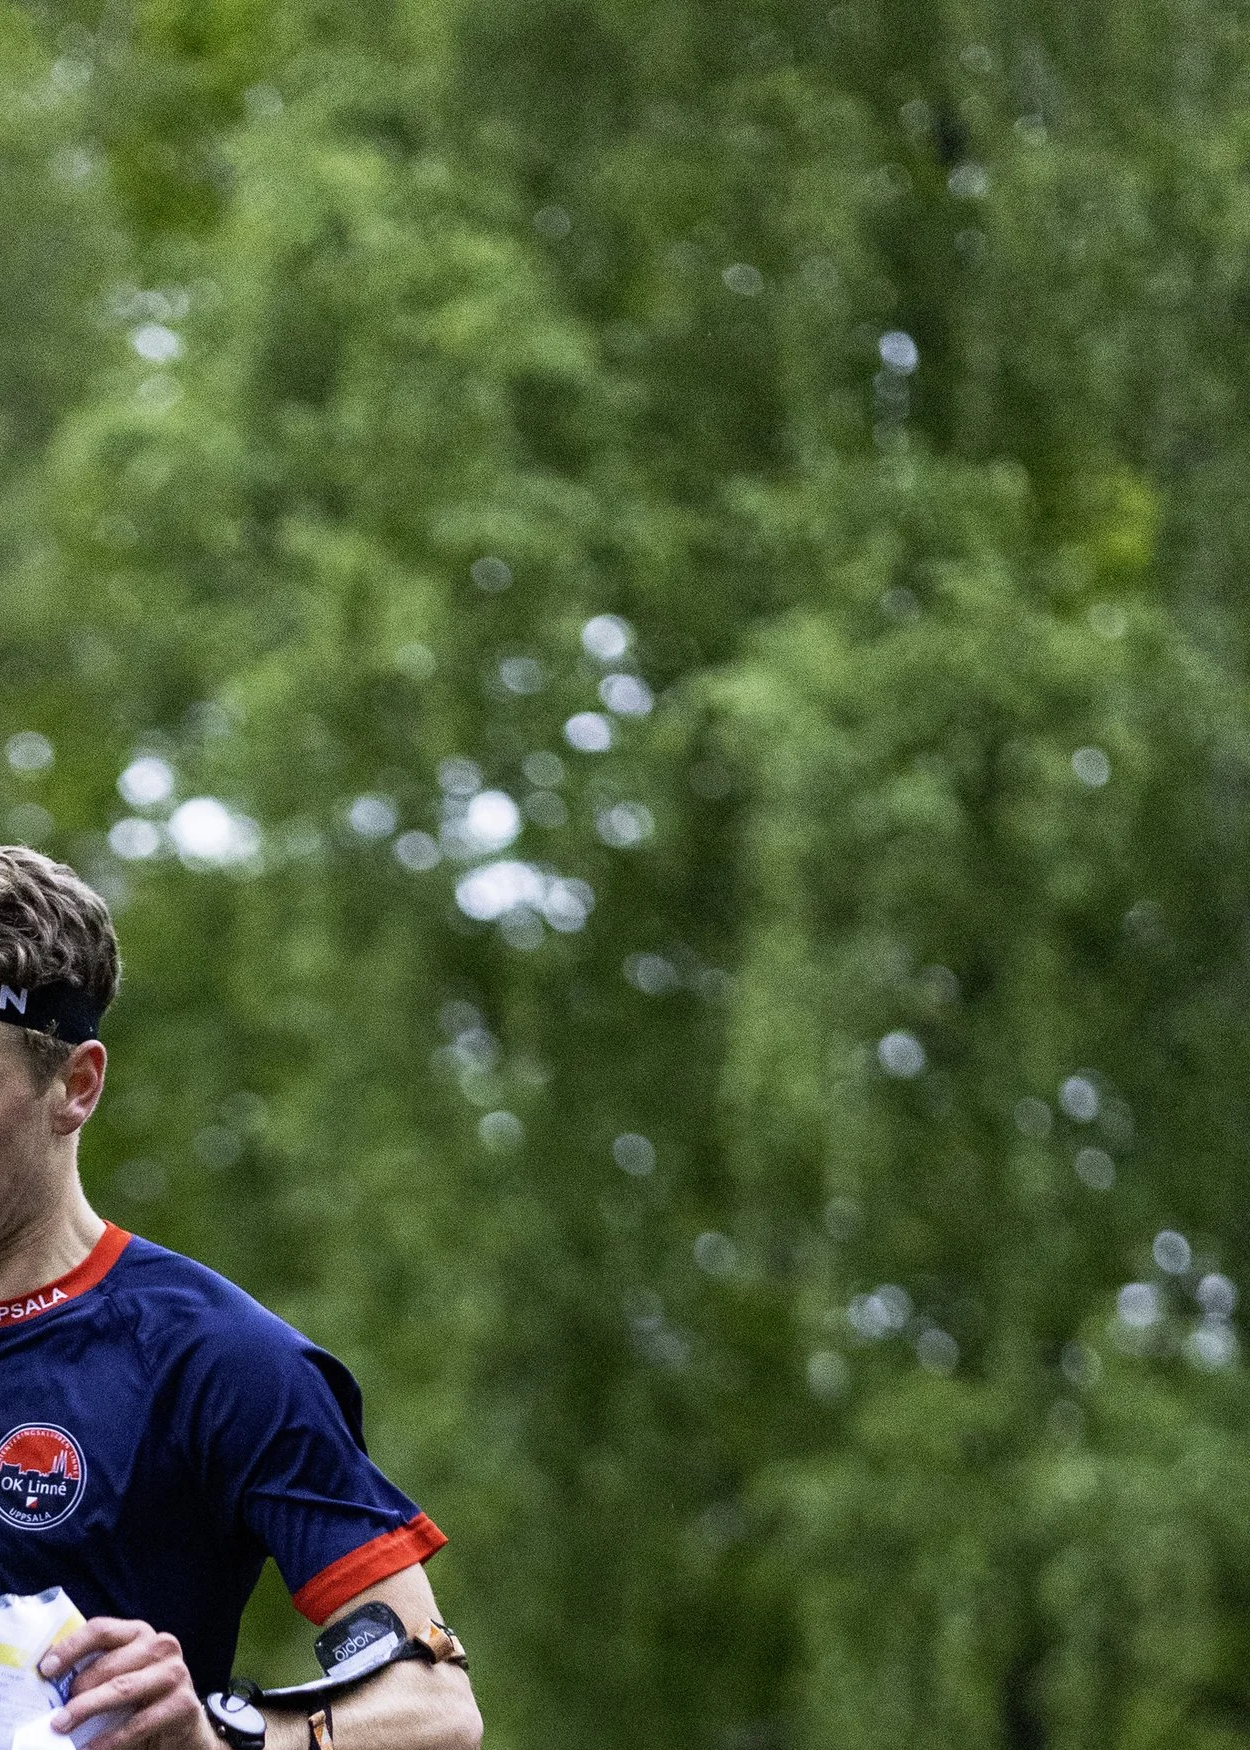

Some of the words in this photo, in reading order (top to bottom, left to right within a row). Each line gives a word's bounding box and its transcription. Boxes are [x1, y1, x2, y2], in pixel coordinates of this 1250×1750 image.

[1, 1476, 23, 1492] OK
[28, 1480, 67, 1496] Linné
[9, 1507, 52, 1522] UPPSALA
